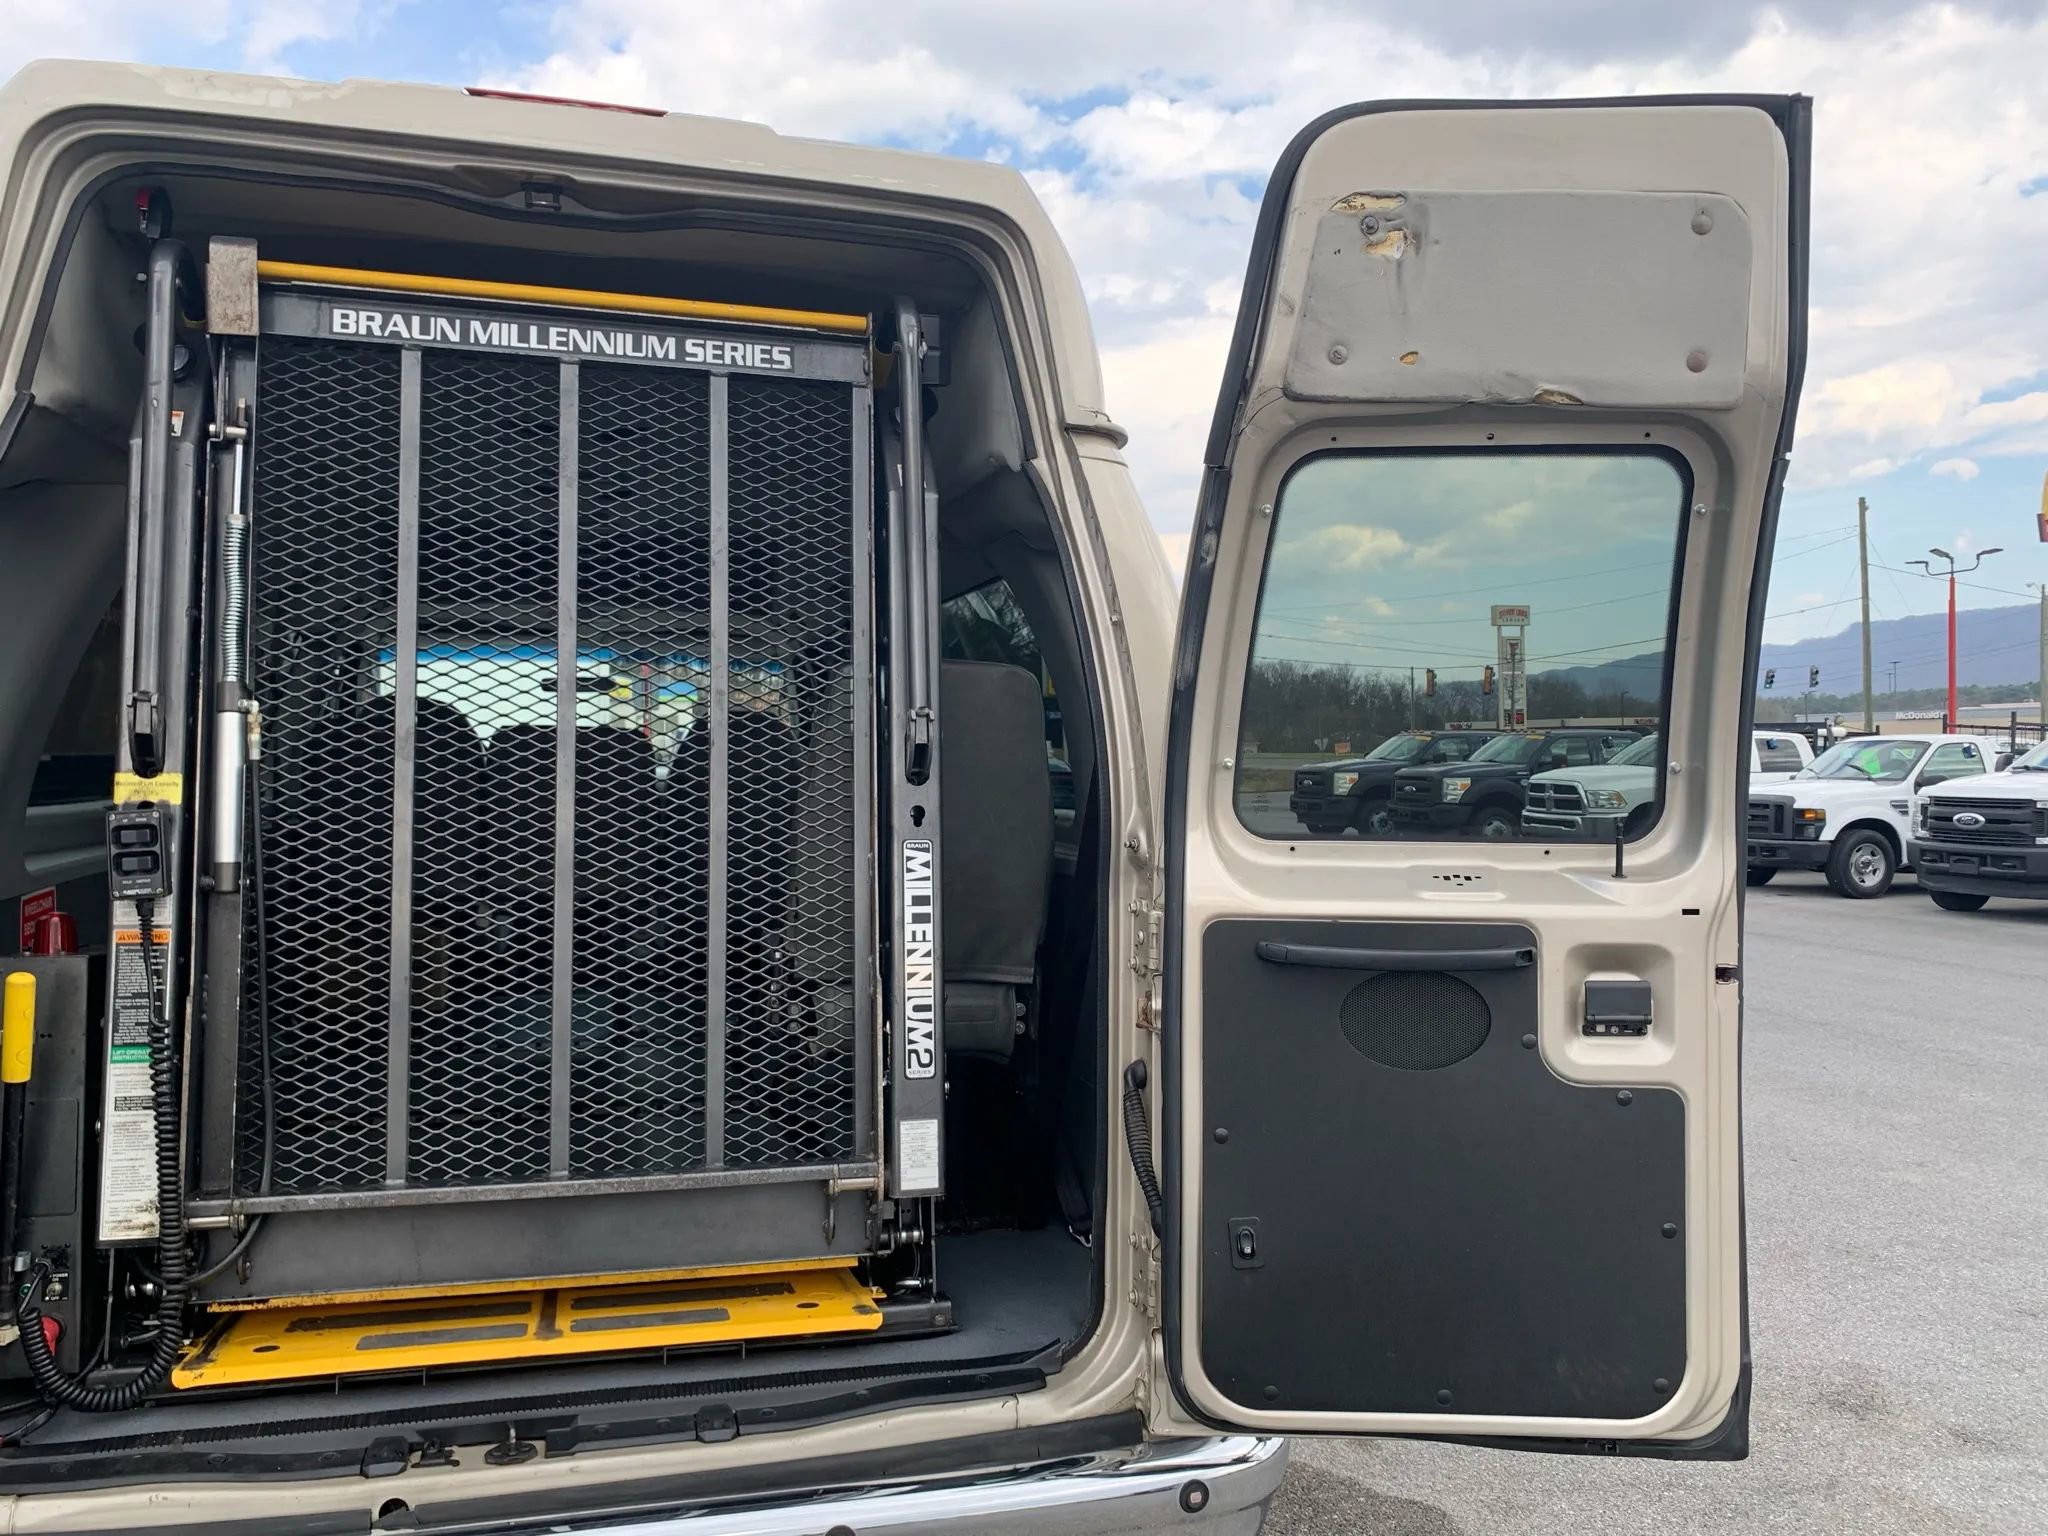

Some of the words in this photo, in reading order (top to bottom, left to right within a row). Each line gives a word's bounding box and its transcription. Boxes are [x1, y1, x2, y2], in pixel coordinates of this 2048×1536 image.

[332, 308, 461, 343] BRAUN
[469, 319, 676, 361] MILLENNIUM
[684, 337, 793, 370] SERIES
[903, 849, 934, 1048] MILLENNIUM
